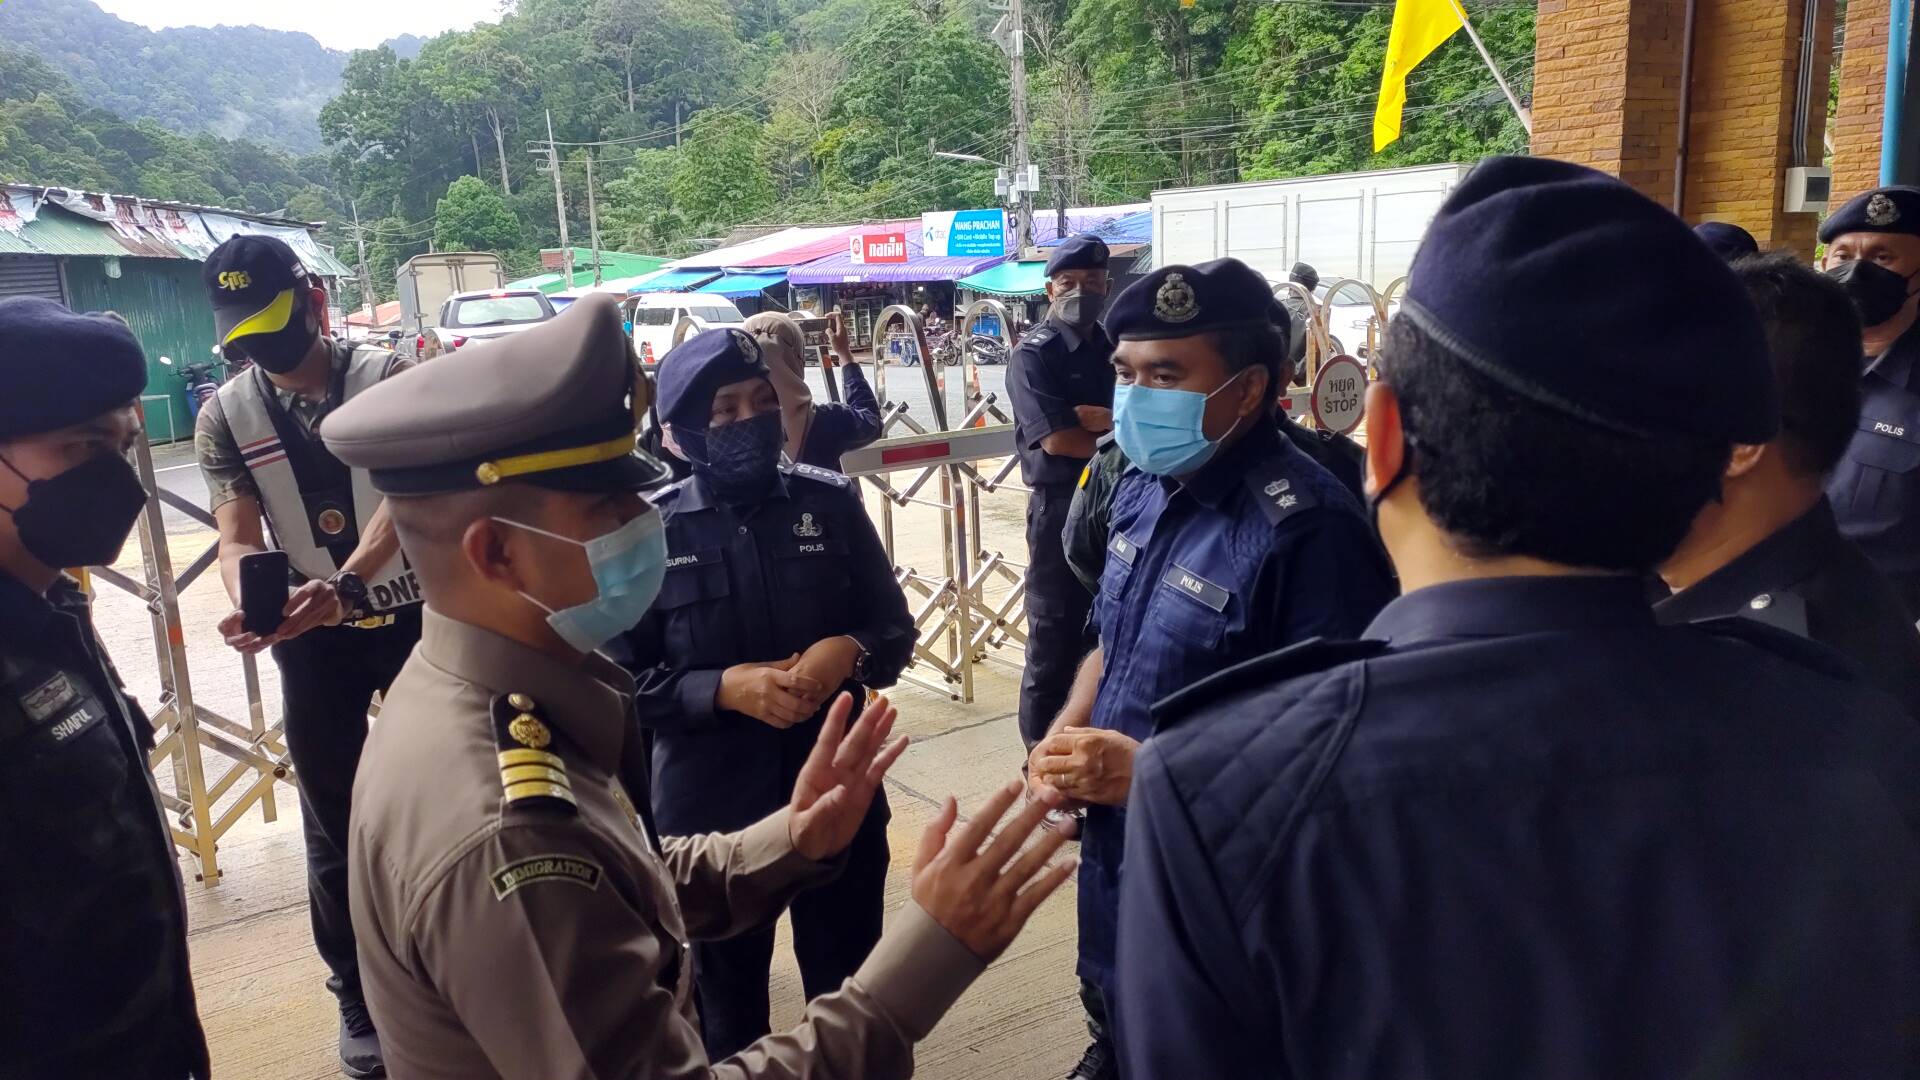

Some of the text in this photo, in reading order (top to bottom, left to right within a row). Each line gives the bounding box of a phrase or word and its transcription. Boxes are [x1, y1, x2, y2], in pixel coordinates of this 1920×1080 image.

[954, 220, 1001, 231] WANG PRACHAN
[1328, 377, 1356, 398] หยุด
[1324, 398, 1358, 414] STOP
[1874, 421, 1905, 437] POLIS
[799, 543, 825, 553] POLIS
[665, 554, 698, 568] SURINA
[1180, 574, 1204, 594] POLIS
[500, 860, 594, 889] IMMIGRATION
